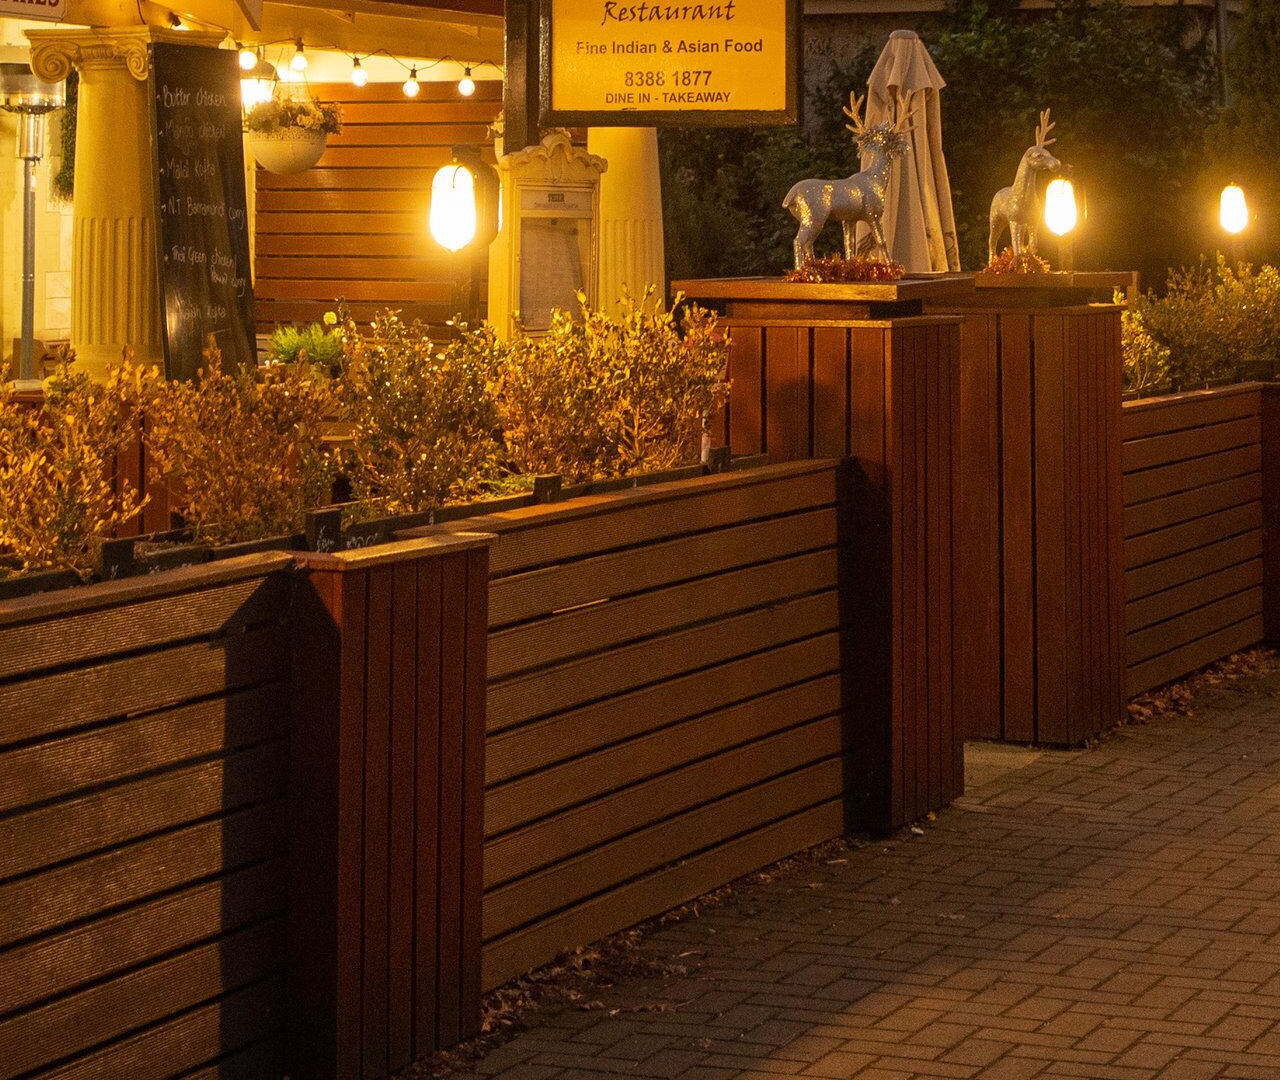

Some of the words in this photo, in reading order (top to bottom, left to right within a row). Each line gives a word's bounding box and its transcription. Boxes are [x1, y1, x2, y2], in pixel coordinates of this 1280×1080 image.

[601, 0, 736, 26] Restaurant
[576, 41, 607, 55] Fine
[612, 41, 657, 54] Indian
[662, 40, 673, 53] &
[677, 39, 719, 53] Asian
[724, 39, 763, 52] Food
[624, 71, 665, 87] 8388
[672, 70, 713, 86] 1877
[605, 92, 634, 104] DINE
[639, 92, 651, 103] IN
[662, 91, 731, 103] TAKEAWAY
